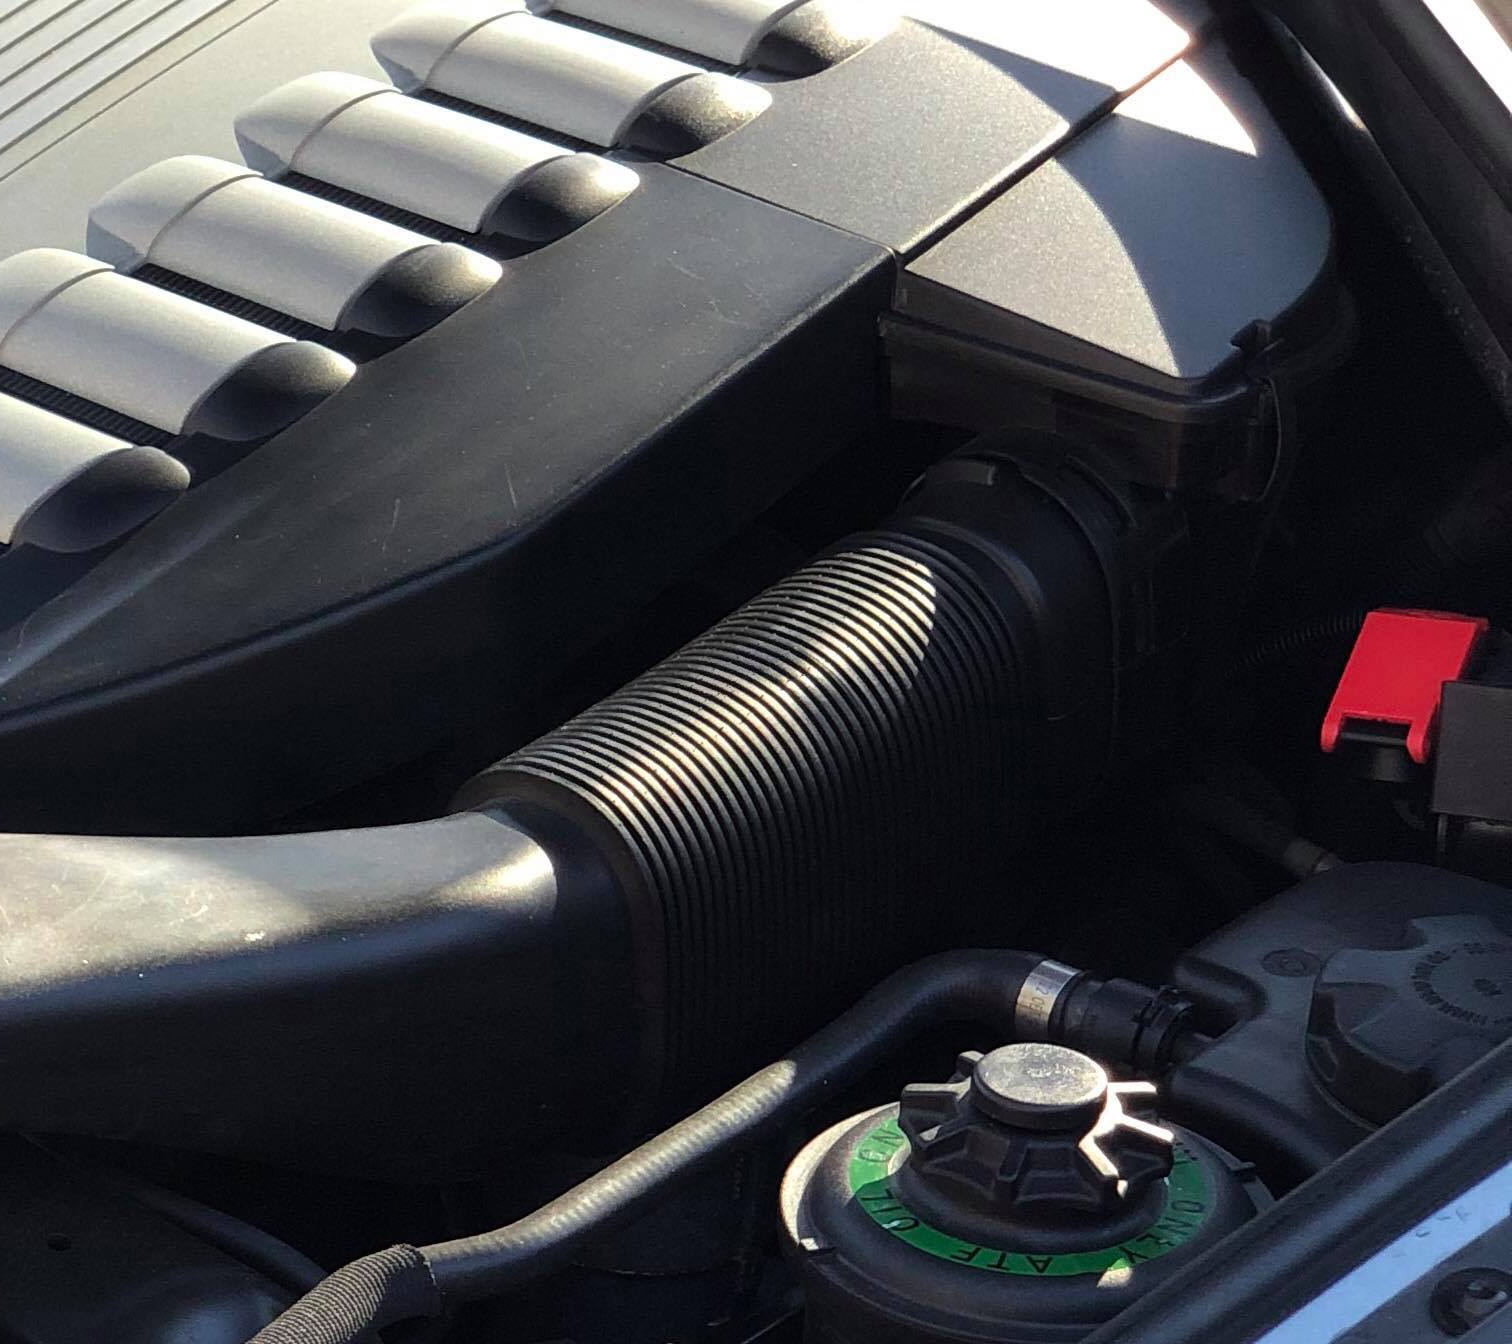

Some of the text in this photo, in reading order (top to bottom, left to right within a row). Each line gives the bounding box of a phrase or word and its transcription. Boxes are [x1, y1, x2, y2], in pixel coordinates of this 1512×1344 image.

[860, 1188, 919, 1232] OIL
[1118, 1199, 1206, 1264] ONLY
[949, 1247, 1053, 1274] ATF
